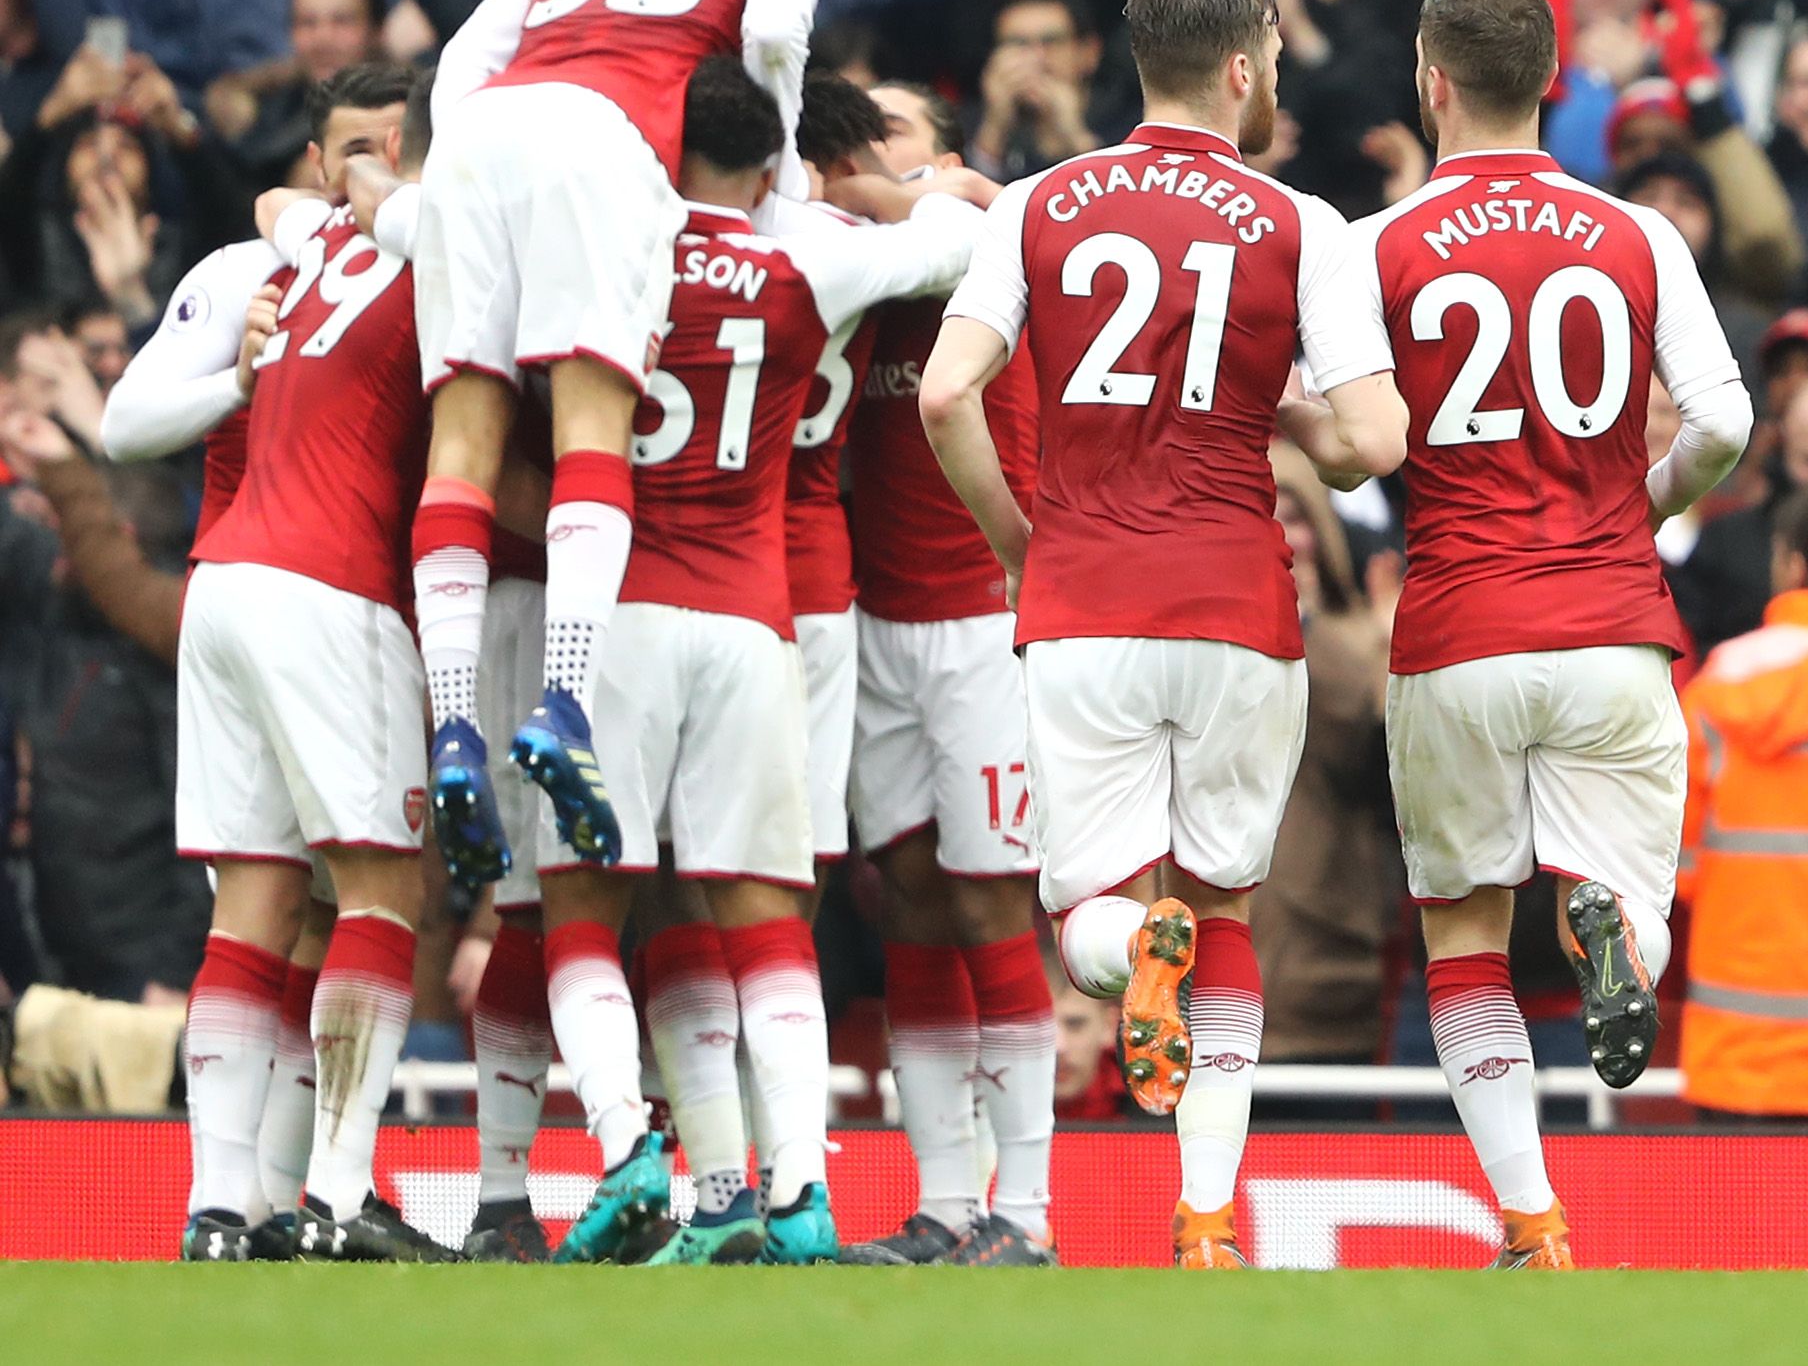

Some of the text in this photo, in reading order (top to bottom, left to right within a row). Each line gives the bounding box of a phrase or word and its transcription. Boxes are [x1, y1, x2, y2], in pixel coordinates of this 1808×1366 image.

[1046, 164, 1275, 244] CHAMBERS
[1422, 199, 1605, 260] MUSTAFI
[673, 250, 768, 302] SON
[1060, 231, 1238, 412] 21
[1409, 264, 1632, 447] 20
[980, 763, 1029, 830] 17
